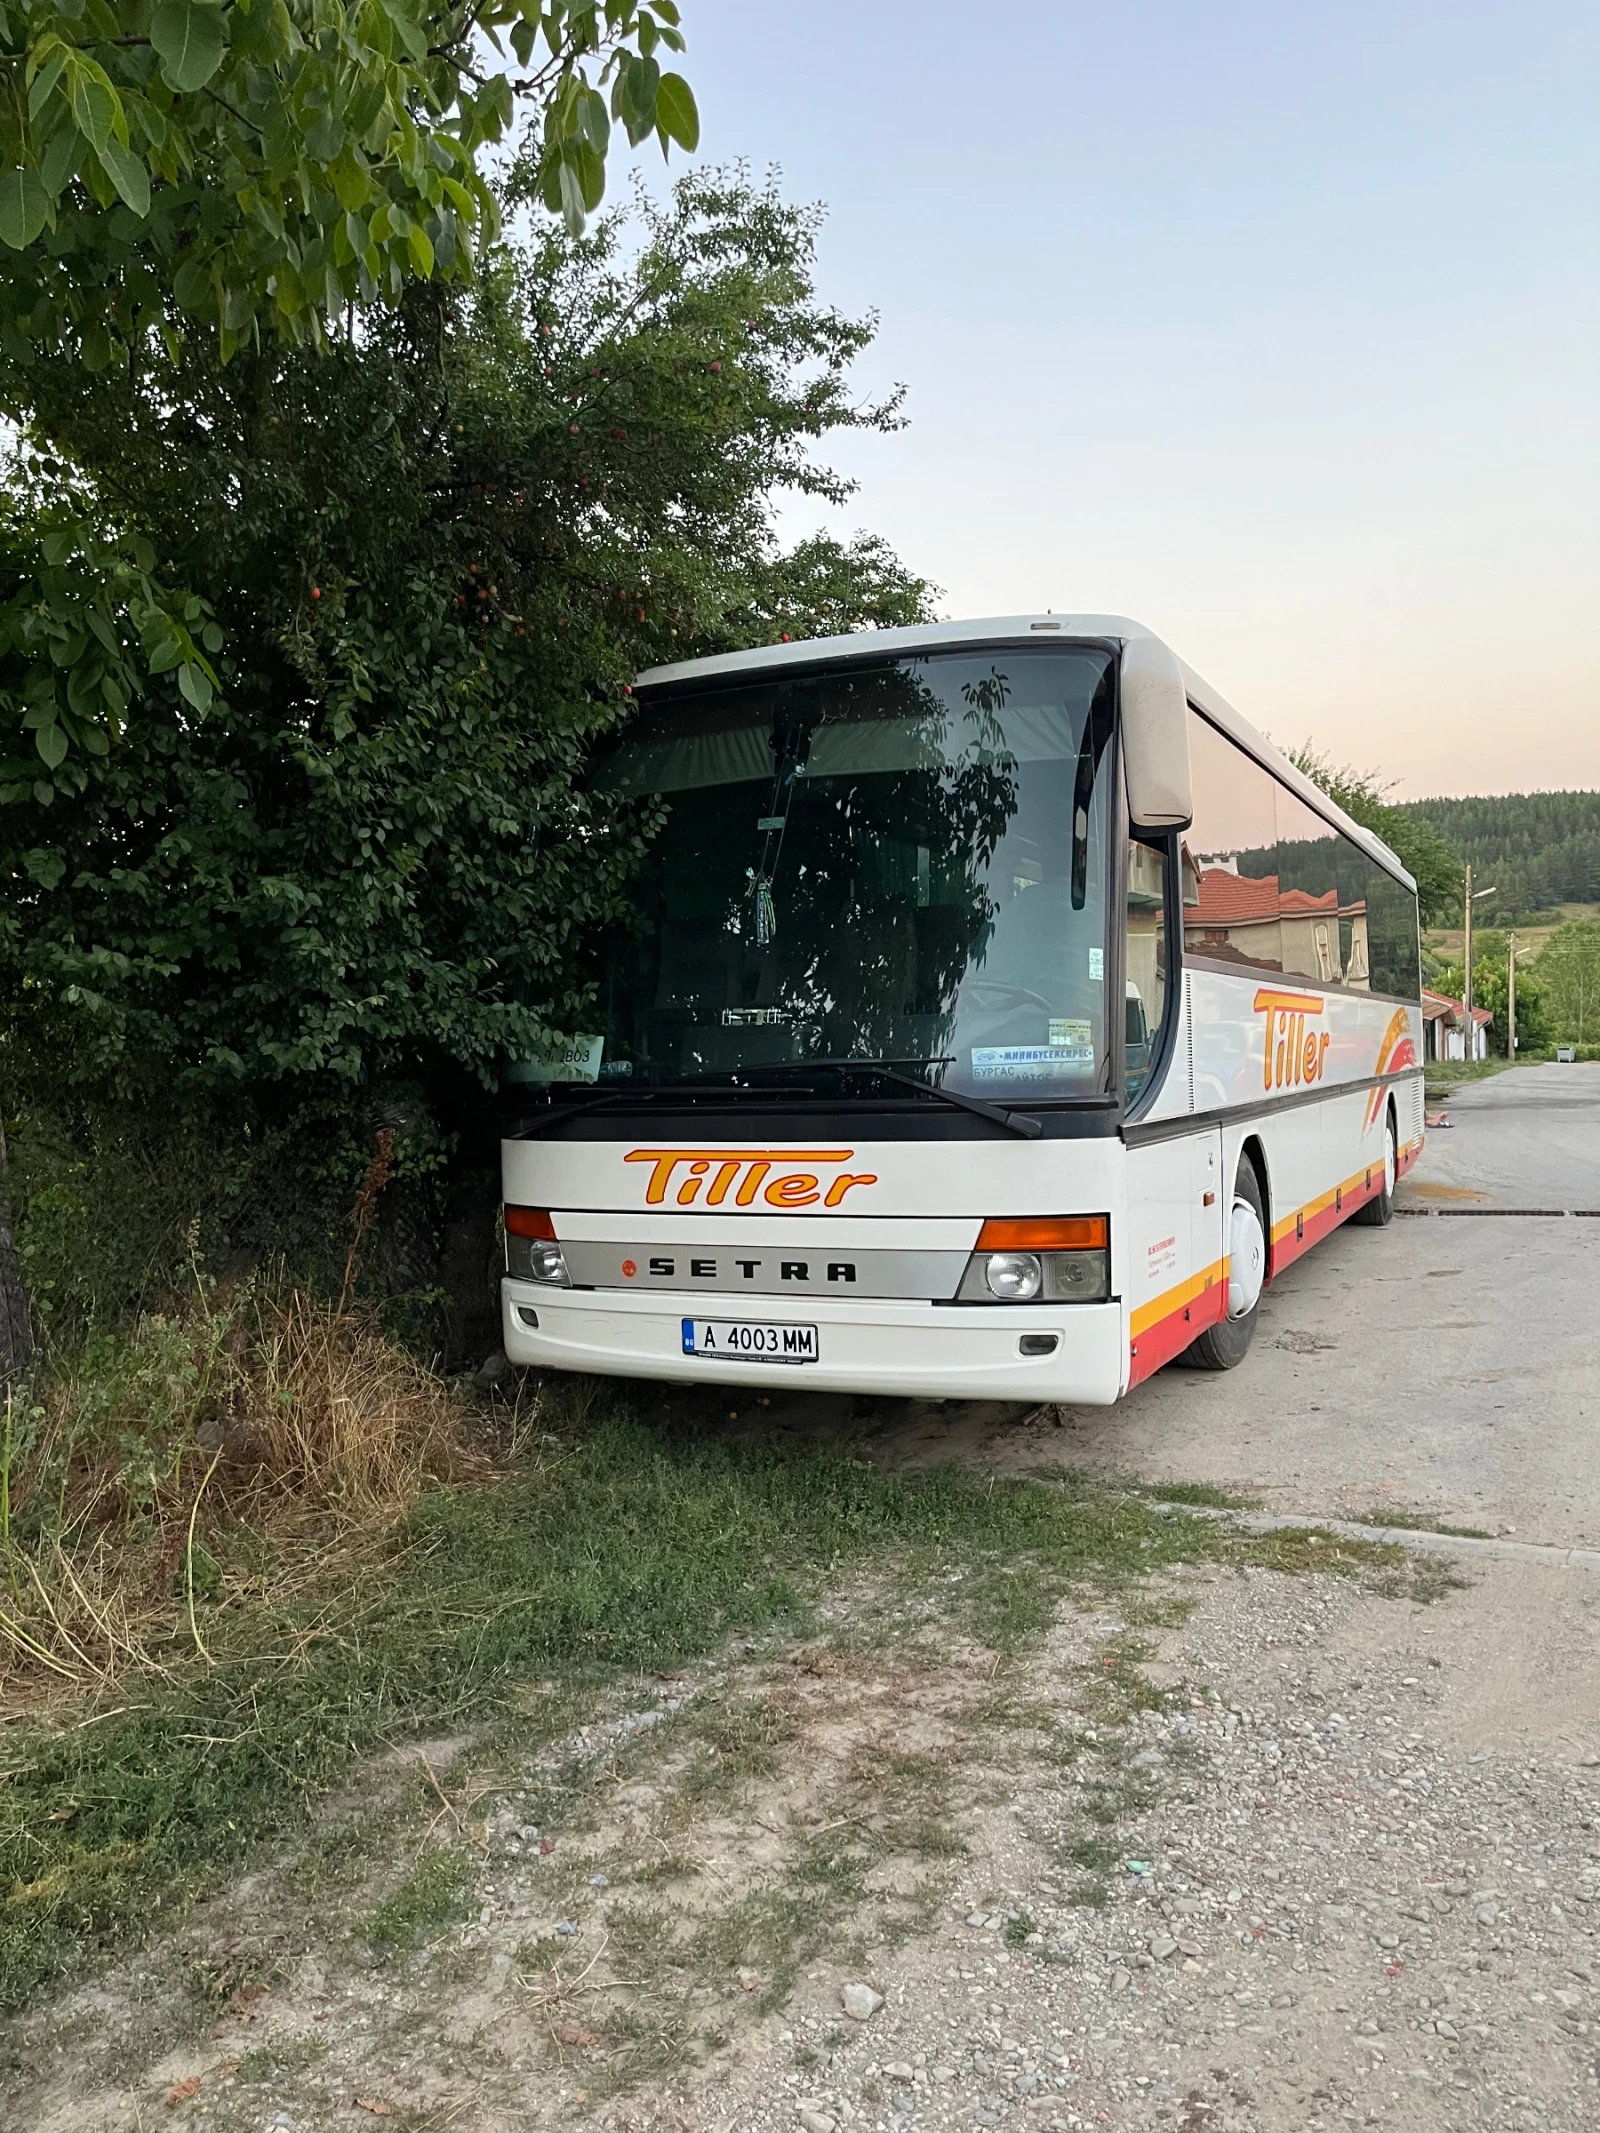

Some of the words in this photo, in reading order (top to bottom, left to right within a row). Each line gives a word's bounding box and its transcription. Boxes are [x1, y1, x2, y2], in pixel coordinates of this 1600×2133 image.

[1254, 988, 1330, 1092] Tiller
[973, 1066, 1015, 1079] БУРГАС
[624, 1149, 878, 1208] Tiller
[649, 1258, 857, 1283] SETRA
[685, 1338, 694, 1346] BG
[704, 1325, 716, 1348] A
[727, 1327, 779, 1352] 4003
[783, 1329, 812, 1354] MM
